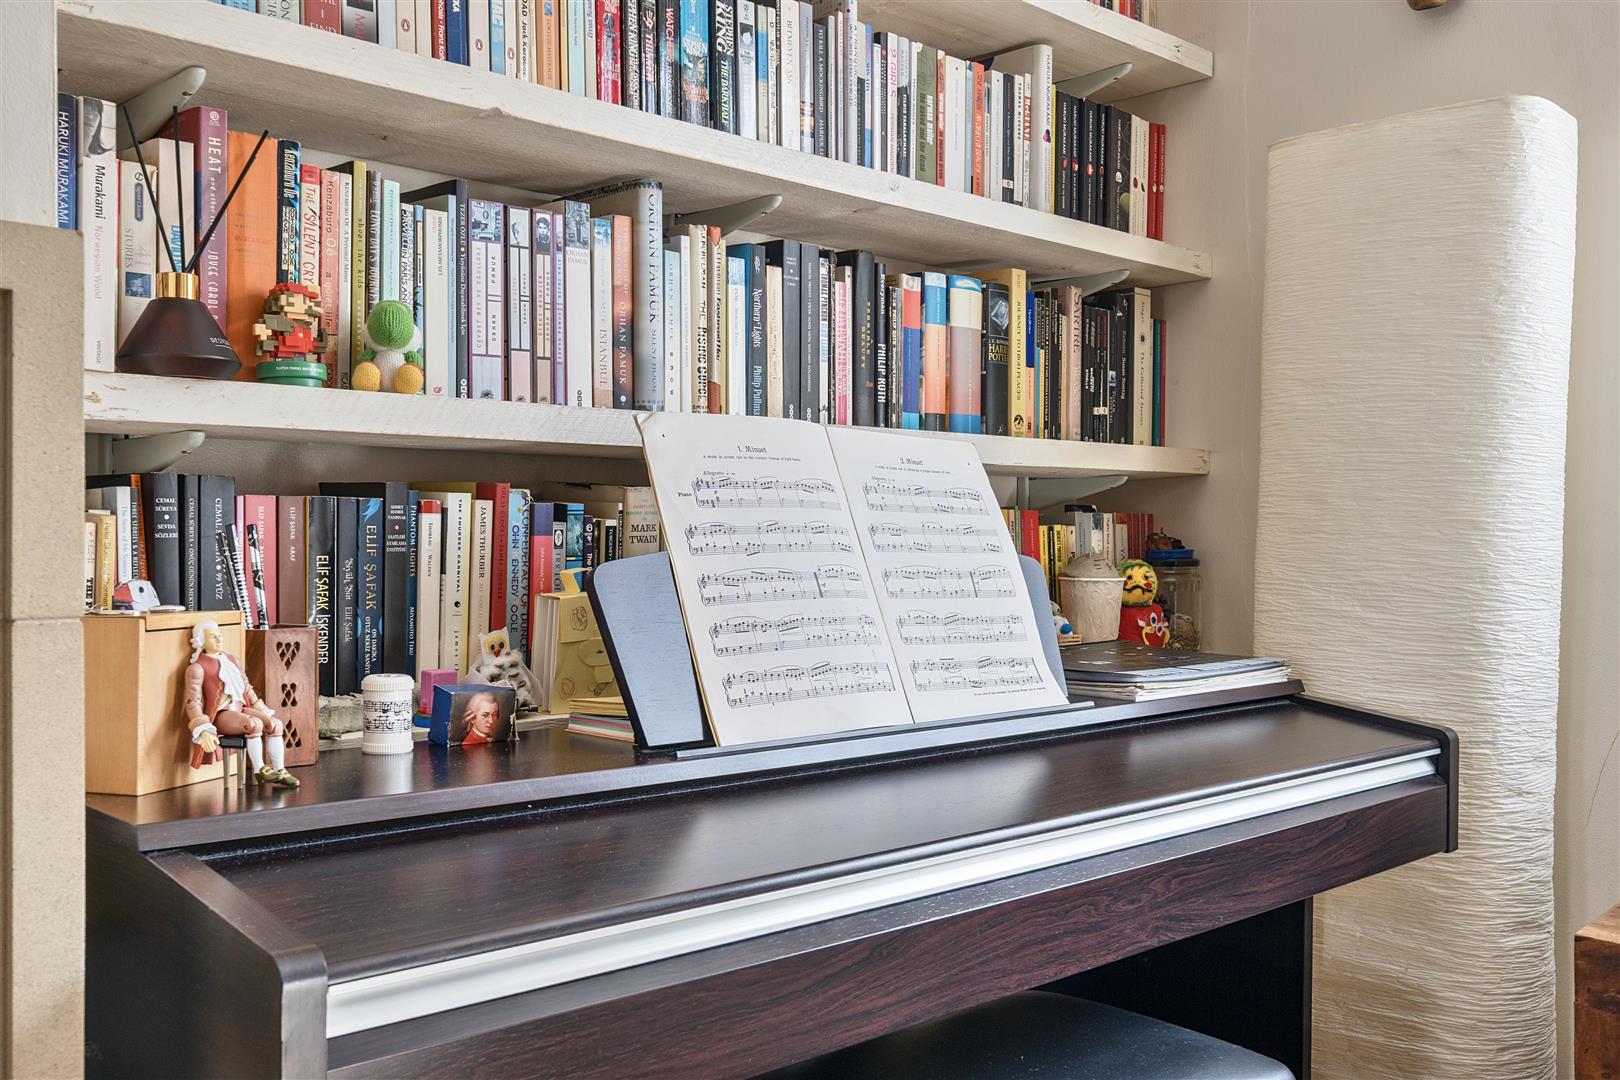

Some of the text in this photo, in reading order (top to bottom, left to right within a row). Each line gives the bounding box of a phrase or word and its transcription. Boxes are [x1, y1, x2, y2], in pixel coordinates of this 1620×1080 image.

[521, 21, 529, 41] Jack
[716, 0, 726, 53] KING
[724, 5, 735, 58] STEPHEN
[818, 28, 824, 40] TO
[645, 33, 655, 82] THINNER
[890, 48, 896, 58] 2
[720, 60, 730, 128] THE DARK HALF
[926, 94, 934, 145] norman mailer
[58, 112, 69, 223] HARUKI MURAKAMI
[208, 136, 223, 174] HEAT
[283, 149, 297, 198] Kenzaburo Oe
[94, 165, 107, 220] Murakami
[209, 192, 218, 214] other
[326, 180, 335, 233] Kenzaburo
[302, 187, 318, 285] THE SILENT CRY
[357, 217, 365, 240] shoot
[369, 209, 379, 236] LONG
[459, 225, 467, 247] ÖZLÜ
[649, 194, 660, 260] ORHAN
[93, 225, 103, 272] Norwegian
[124, 228, 134, 268] STORIES
[208, 249, 219, 276] JOYCE
[369, 237, 379, 262] DAY'S
[369, 266, 380, 305] JOURNEY
[458, 253, 467, 283] Yeryüzüne
[94, 276, 103, 300] Wood
[208, 281, 218, 310] CAROL
[324, 281, 333, 311] quiet
[458, 283, 467, 323] Dayanabilmek
[649, 263, 660, 326] PAMUK
[820, 273, 828, 322] THOMAS PYNCHON
[751, 287, 763, 388] Northern Lights Philip
[1073, 292, 1082, 353] SARTRE
[618, 301, 626, 385] ORHAN PAMUK
[697, 326, 707, 365] RISING
[1016, 338, 1021, 349] TO
[697, 366, 707, 403] GORGE
[877, 343, 886, 403] PHILIP ROTH
[745, 446, 768, 454] Minuet
[188, 519, 196, 543] SÜREYA
[287, 521, 296, 540] ŞAFAK
[289, 506, 297, 520] ELİF
[409, 505, 418, 546] PHANTOM
[630, 523, 657, 532] MARK
[187, 548, 196, 566] ONÜÇ
[214, 497, 224, 600] CEMAL 99 YÜZ
[477, 506, 487, 579] JAMES THURBER
[628, 535, 658, 544] TWAIN
[188, 566, 196, 588] GÜNÜN
[362, 524, 379, 610] ELİF ŞAFAK
[409, 548, 418, 577] LIGHTS
[520, 509, 530, 610] CONFEDERACY OF
[85, 578, 94, 598] THE
[313, 555, 332, 665] ELİF ŞAFAK İSKENDER
[342, 606, 353, 643] Elif Şafak
[364, 634, 372, 652] SEKİZ
[370, 628, 379, 662] ON DAKİKA
[364, 653, 373, 675] SANİYE
